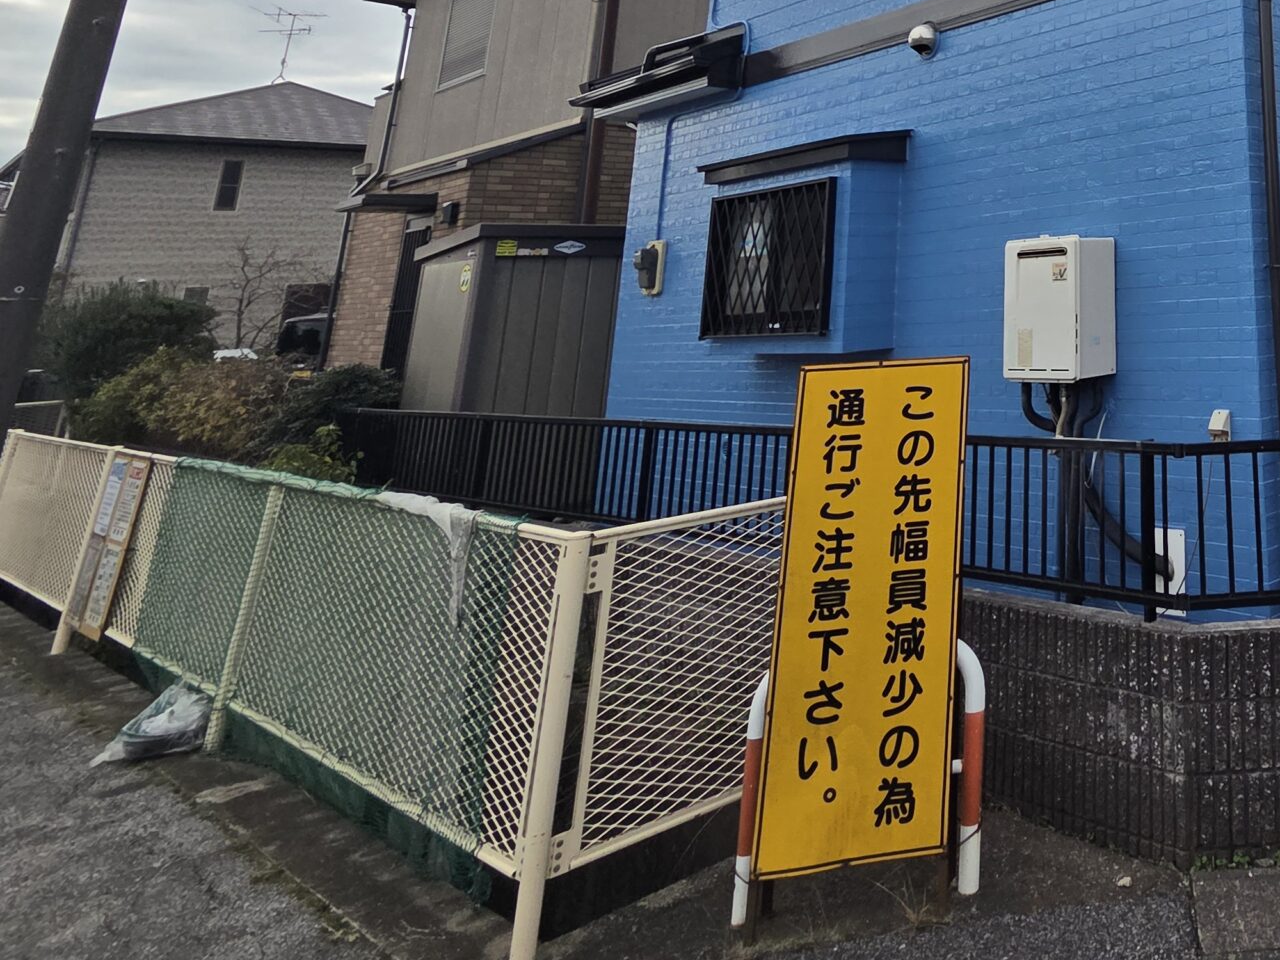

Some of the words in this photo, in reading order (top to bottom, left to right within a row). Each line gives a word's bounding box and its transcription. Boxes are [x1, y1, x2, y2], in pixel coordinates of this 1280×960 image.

[797, 388, 867, 804] 通行ご注意下さい。
[873, 386, 936, 828] この先幅員減少の為
